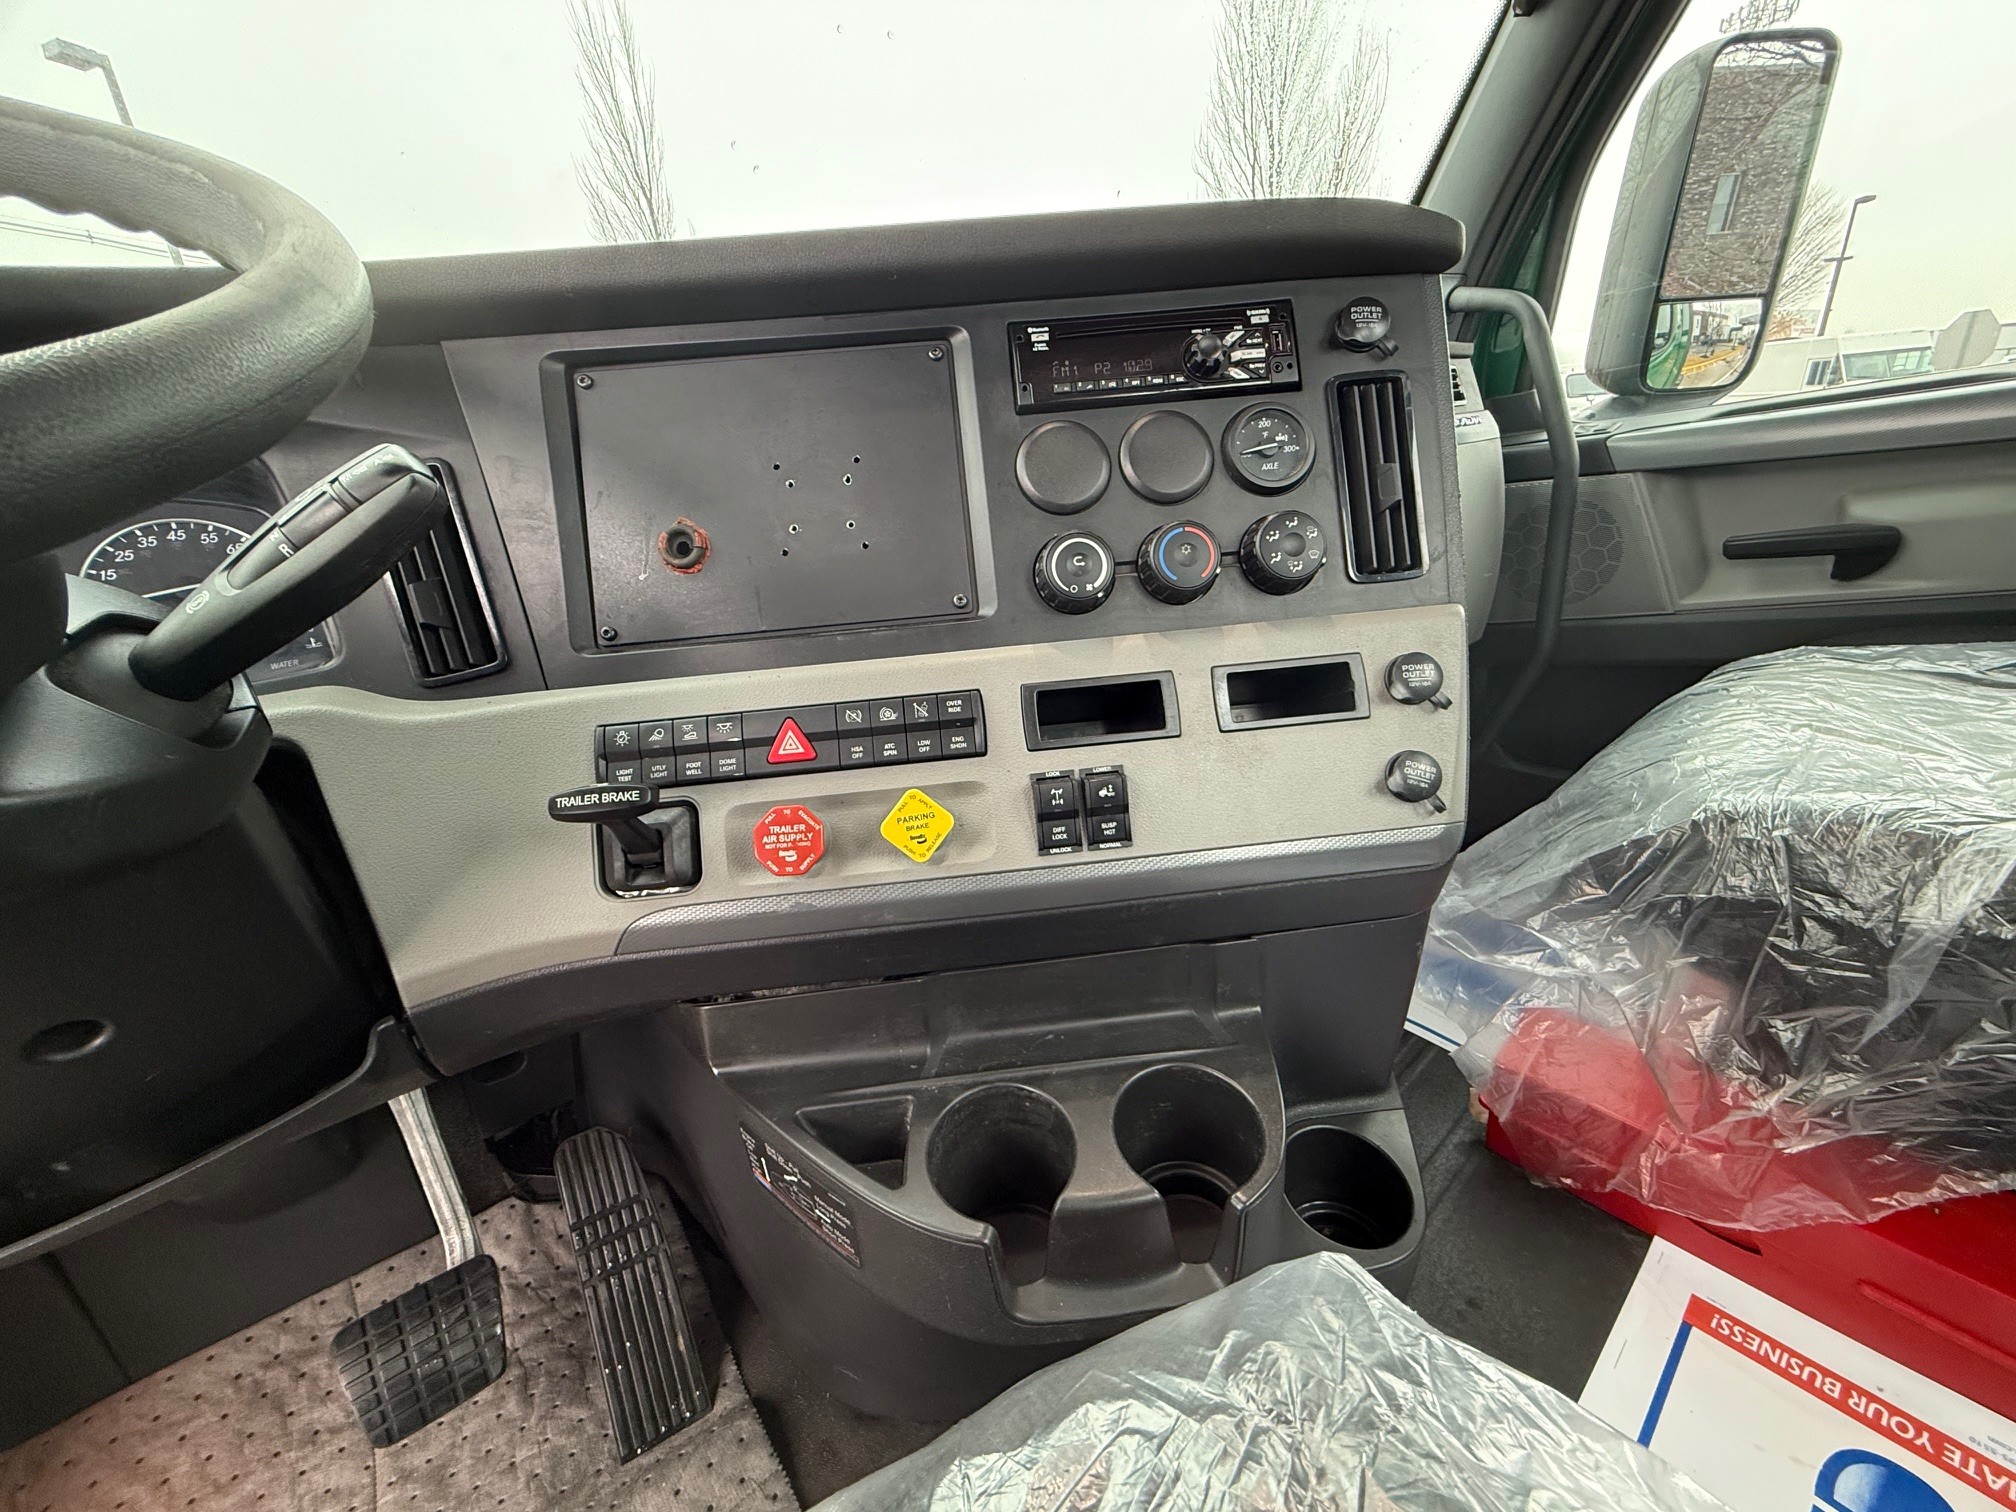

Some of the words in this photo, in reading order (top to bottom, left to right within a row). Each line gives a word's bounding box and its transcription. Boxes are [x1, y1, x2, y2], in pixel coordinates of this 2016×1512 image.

[1258, 420, 1271, 428] 200
[1283, 445, 1296, 453] 300
[1261, 462, 1279, 471] AXLE
[137, 535, 157, 548] 35
[166, 530, 186, 541] 45
[200, 533, 218, 544] 55
[114, 550, 134, 562] 25
[278, 543, 294, 557] R
[99, 569, 117, 581] 15
[270, 660, 299, 669] WATER
[1402, 663, 1435, 671] POWER
[1402, 670, 1435, 678] OUTLET
[1405, 760, 1437, 774] POWER
[1404, 767, 1436, 780] OUTLET
[555, 793, 599, 808] TRAILER
[601, 790, 640, 803] BRAKE
[898, 802, 908, 812] PULL
[918, 798, 933, 809] APPLY
[764, 813, 776, 824] PULL
[798, 810, 821, 830] EVACUATE
[897, 812, 935, 824] PARKING
[769, 824, 806, 834] TRAILER
[906, 823, 929, 832] BRAKE
[762, 835, 777, 843] AIR
[779, 832, 813, 842] SUPPLY
[903, 845, 916, 855] PUSH
[926, 832, 942, 853] RELEASE
[766, 860, 779, 872] PUSH
[1710, 1314, 1842, 1400] BUSINESS!
[1848, 1390, 1934, 1454] YOUR
